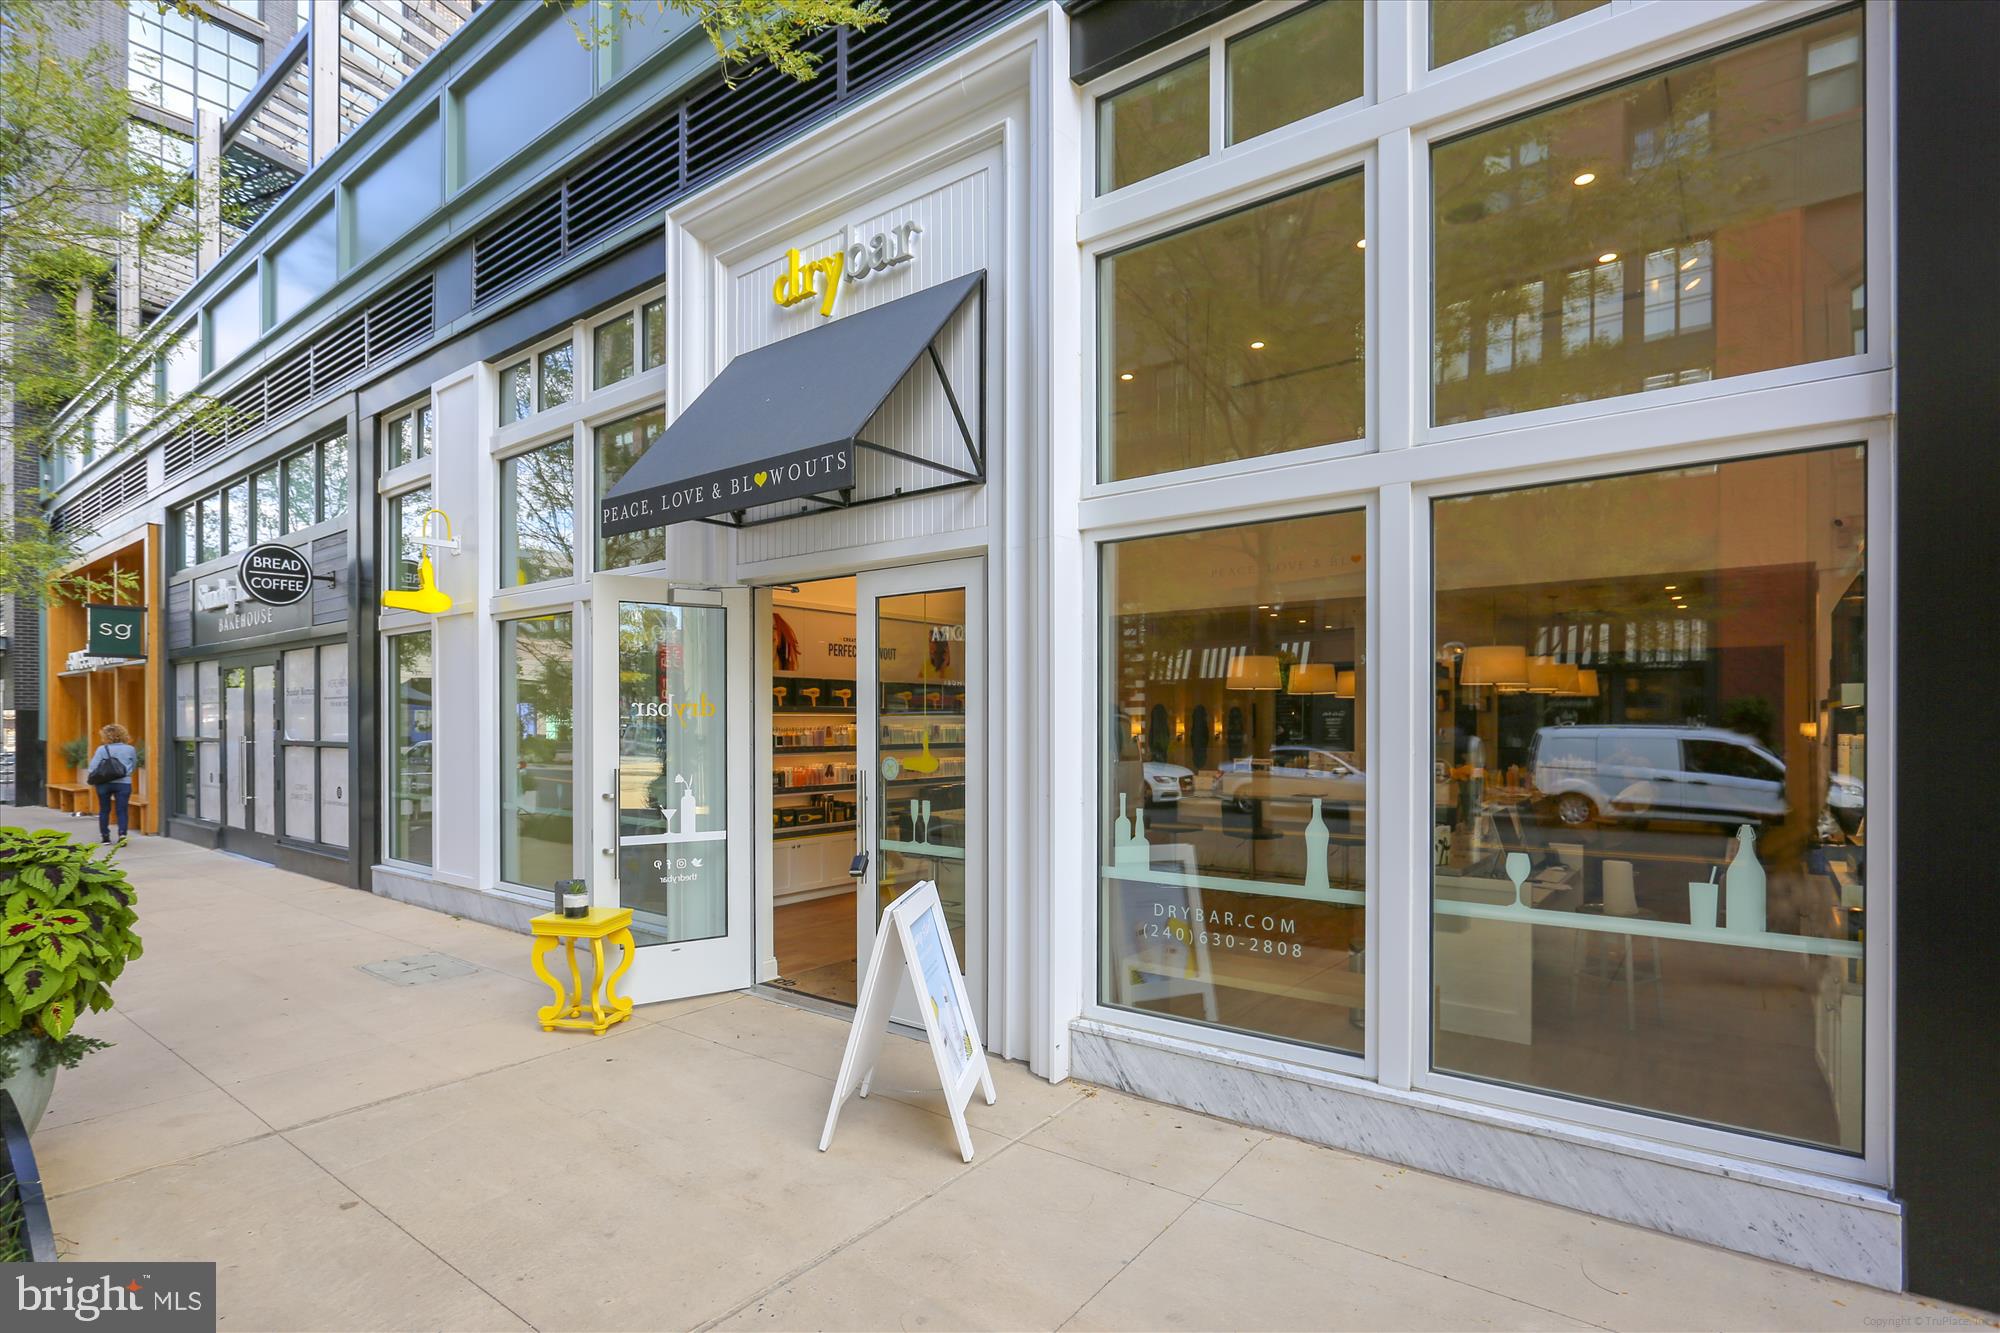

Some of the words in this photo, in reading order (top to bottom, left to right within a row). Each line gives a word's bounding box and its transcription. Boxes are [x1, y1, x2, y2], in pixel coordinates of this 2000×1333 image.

[773, 220, 922, 317] drybar
[603, 500, 653, 524] PEACE,
[662, 486, 704, 510] LOVE
[712, 483, 721, 499] &
[253, 556, 301, 571] BREAD
[251, 577, 303, 592] COFFEE
[99, 622, 132, 640] sg
[218, 607, 272, 632] BAKEHOUSE
[1154, 903, 1295, 934] DRYBAR.COM
[1143, 924, 1302, 958] (240)630-2808
